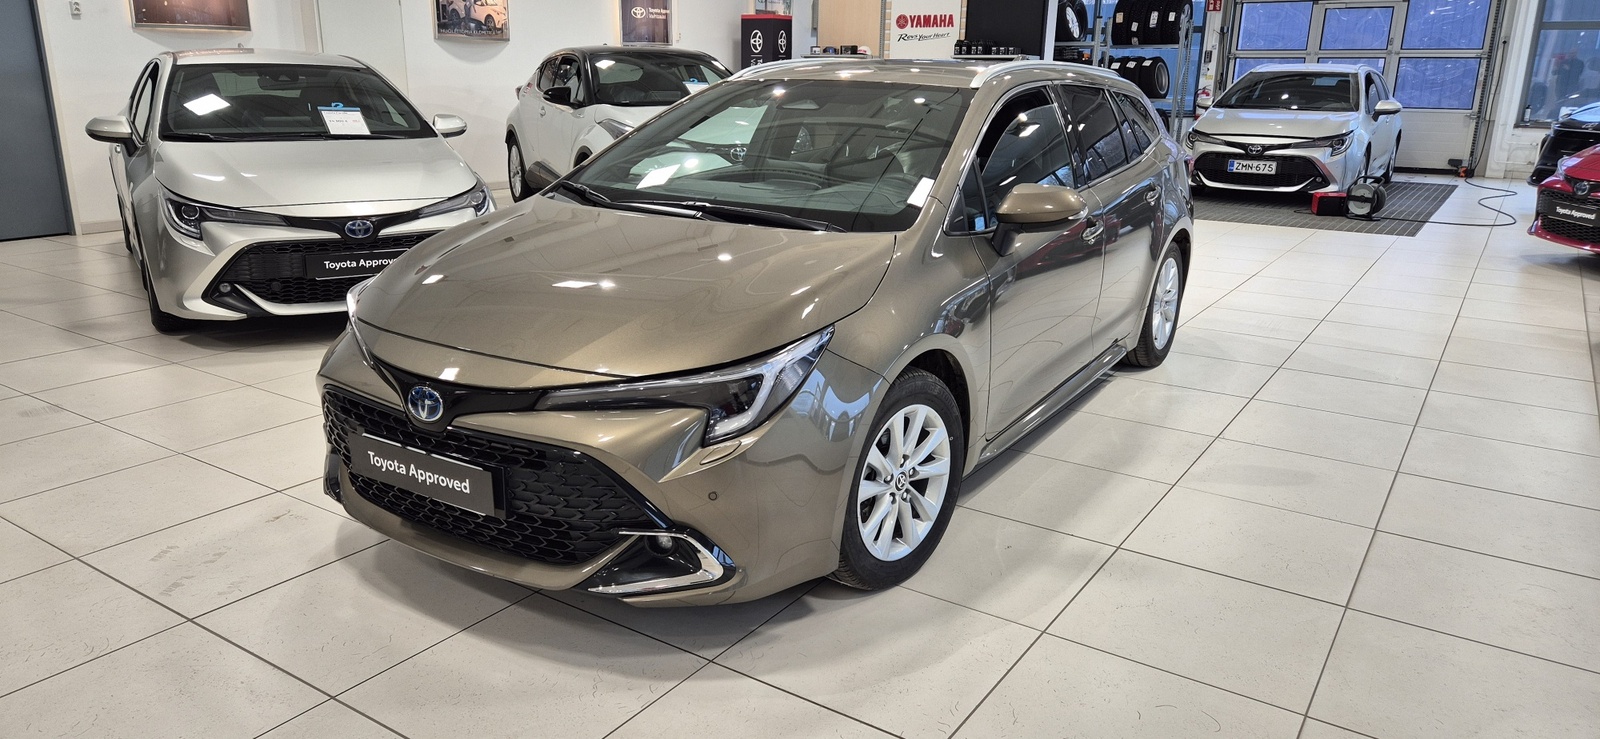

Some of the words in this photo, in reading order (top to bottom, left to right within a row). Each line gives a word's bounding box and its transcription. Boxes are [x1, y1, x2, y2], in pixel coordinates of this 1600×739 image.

[909, 14, 955, 28] YAMAHA
[897, 33, 918, 42] Revs
[1235, 162, 1274, 173] ZMN-675
[1556, 206, 1571, 215] Toyota
[1571, 210, 1596, 220] Approved
[323, 260, 357, 271] Toyota
[358, 258, 397, 269] Approv
[367, 450, 407, 475] Toyota
[409, 463, 470, 494] Approved
